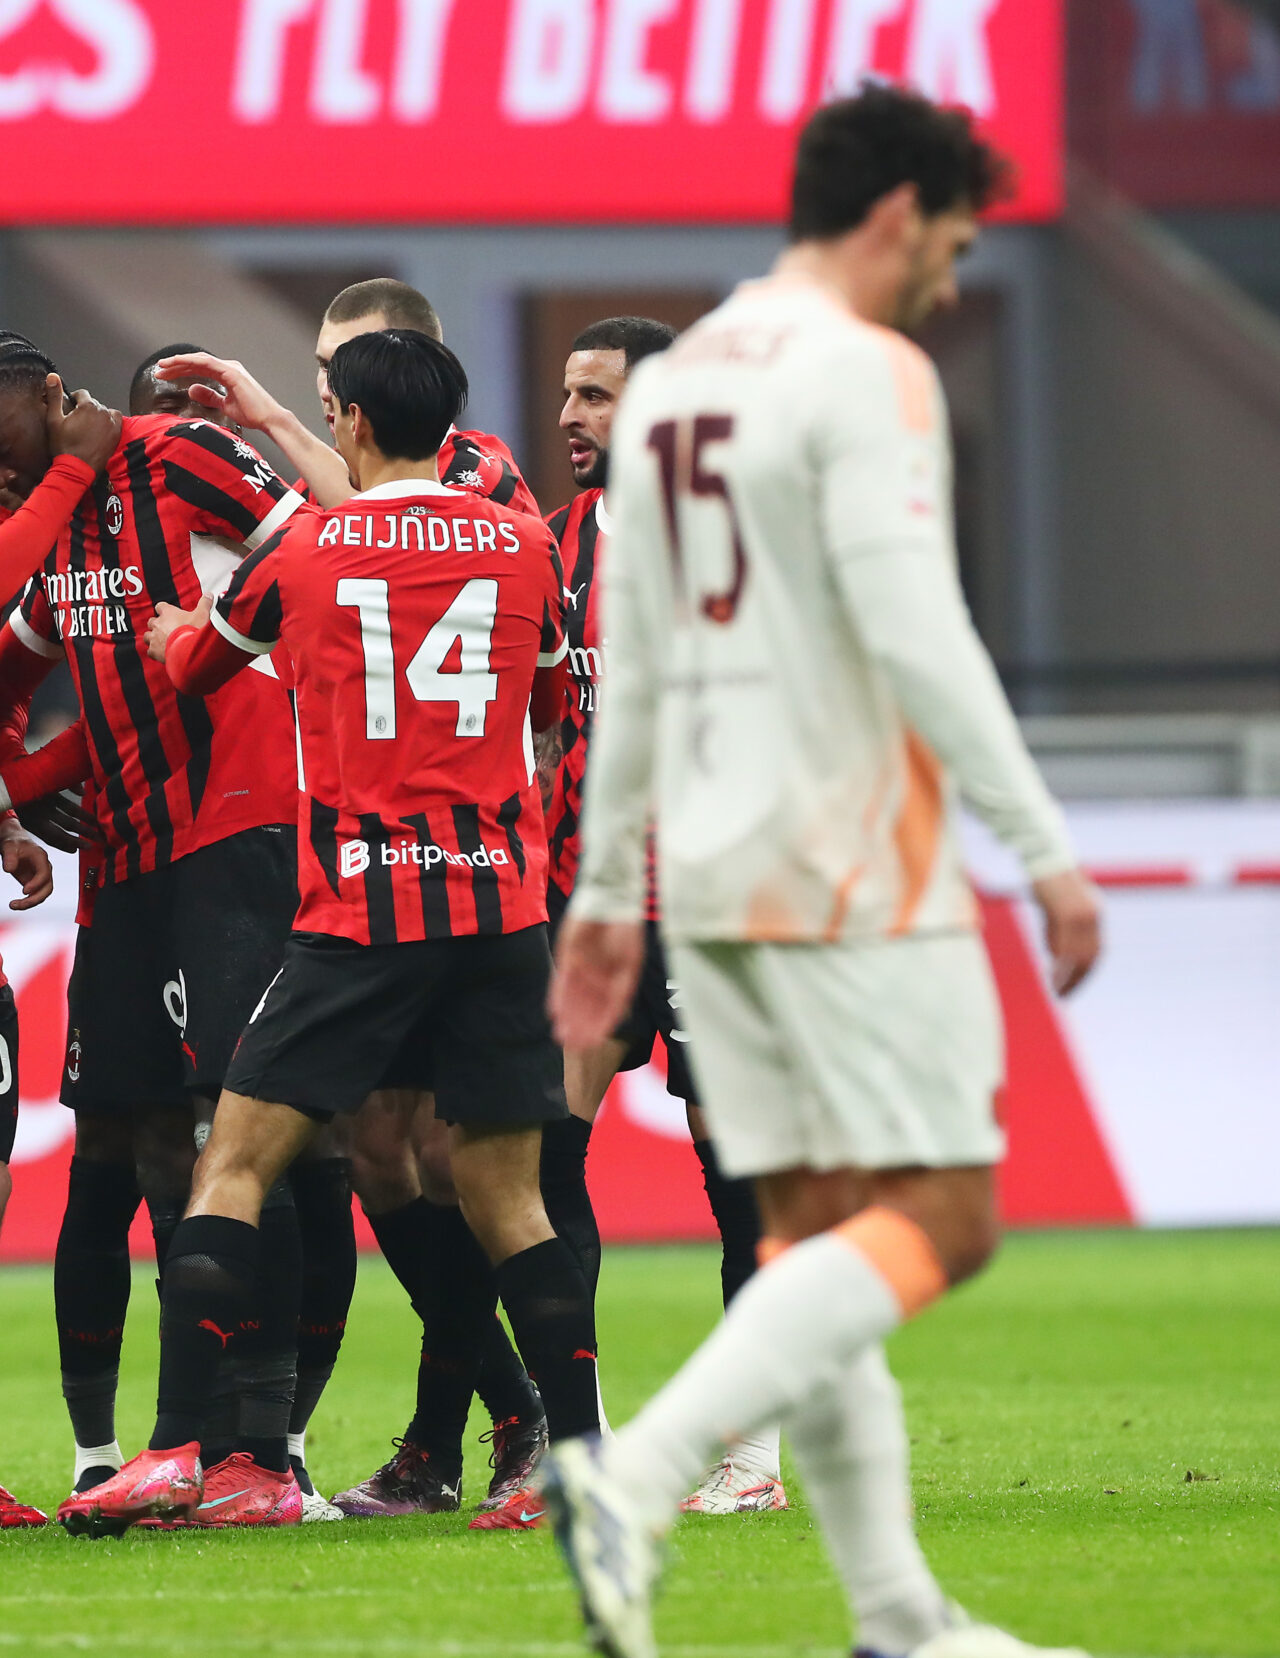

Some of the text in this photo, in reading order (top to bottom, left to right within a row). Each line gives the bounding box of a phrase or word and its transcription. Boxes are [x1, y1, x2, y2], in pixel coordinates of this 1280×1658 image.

[317, 514, 521, 553] REIJNDERS
[648, 414, 750, 626] 15
[40, 563, 144, 607] mirates
[67, 604, 129, 637] BETTER
[335, 577, 500, 741] 14
[381, 839, 510, 871] bitpanda
